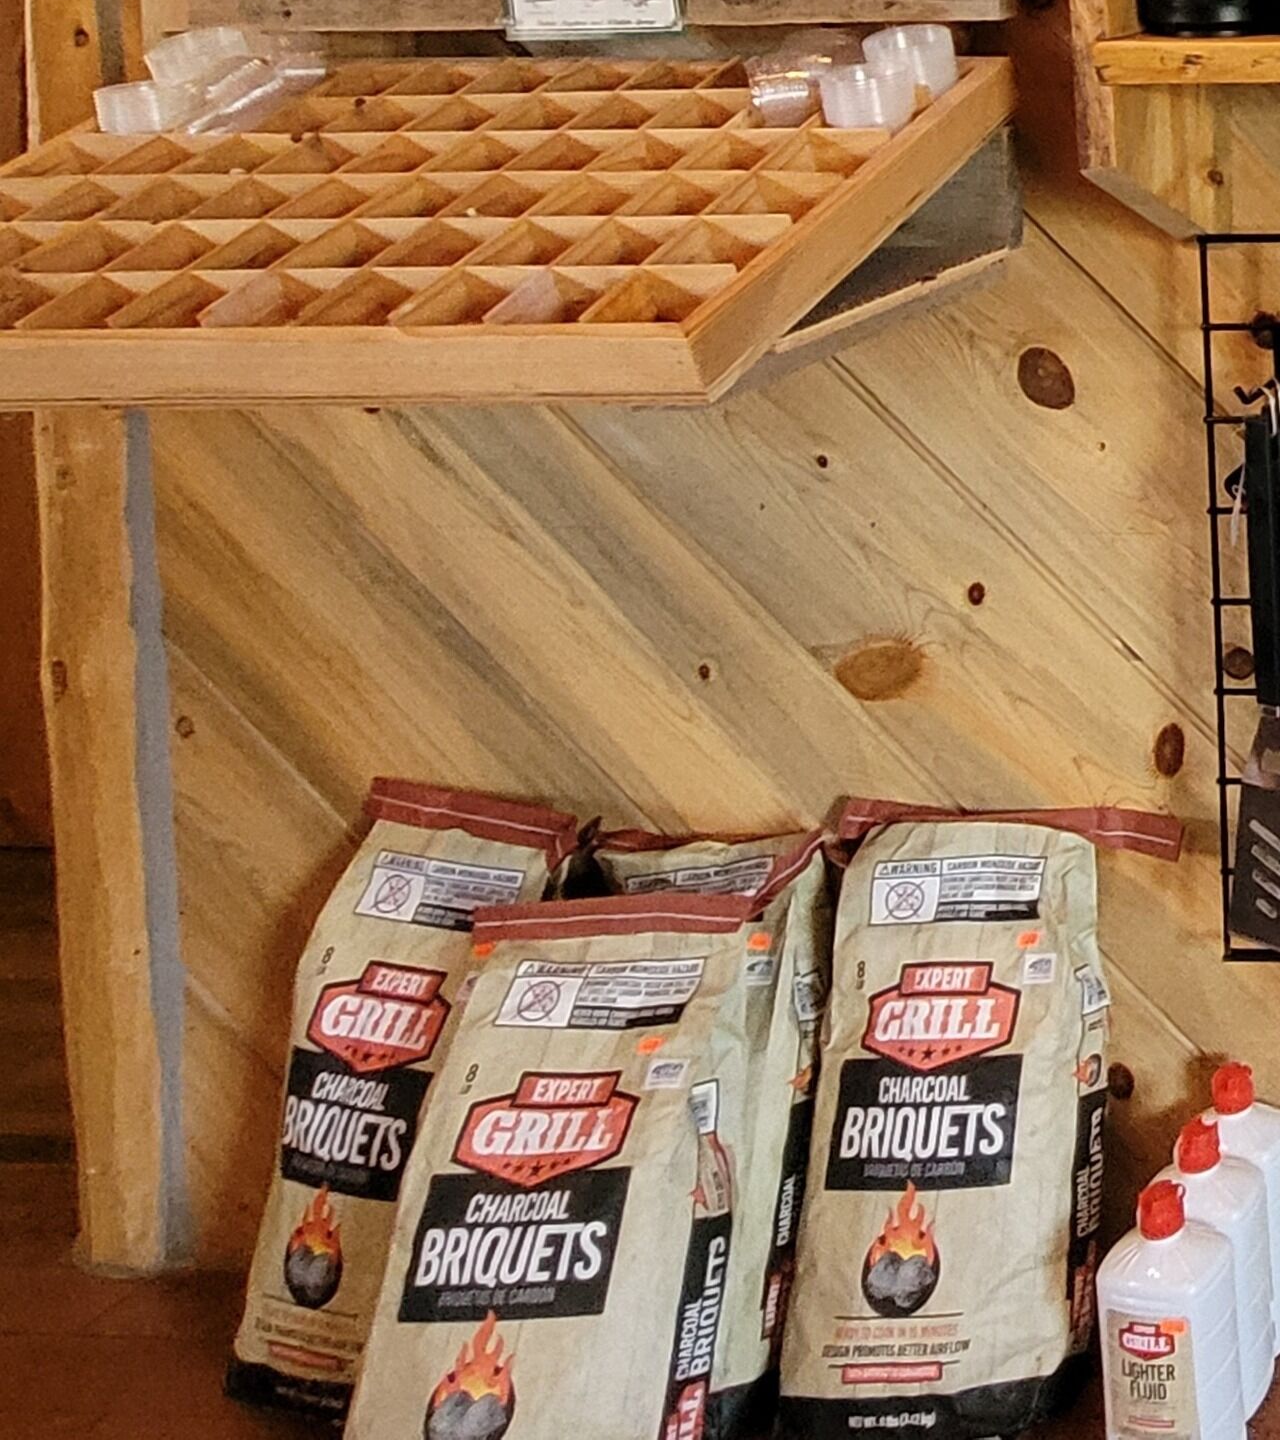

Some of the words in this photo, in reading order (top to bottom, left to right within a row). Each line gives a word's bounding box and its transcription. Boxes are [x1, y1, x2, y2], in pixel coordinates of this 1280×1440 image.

[890, 862, 938, 874] WARNING
[372, 971, 429, 997] EXPERT
[913, 967, 973, 990] EXPERT
[320, 994, 433, 1050] GRILL
[874, 998, 1001, 1042] GRILL
[312, 1072, 390, 1110] CHARCOAL
[533, 1078, 600, 1102] EXPERT
[878, 1075, 971, 1104] CHARCOAL
[284, 1096, 407, 1171] BRIQUETS
[471, 1109, 616, 1157] GRILL
[839, 1103, 1007, 1161] BRIQUETS
[465, 1190, 572, 1225] CHARCOAL
[414, 1221, 608, 1288] BRIQUETS
[675, 1297, 702, 1381] CHARCOAL
[851, 1343, 895, 1358] PROMOTES
[896, 1342, 928, 1357] BETTER
[930, 1339, 972, 1356] AIRFLOW
[1121, 1358, 1176, 1382] LIGHTER
[1129, 1380, 1168, 1401] FLUID
